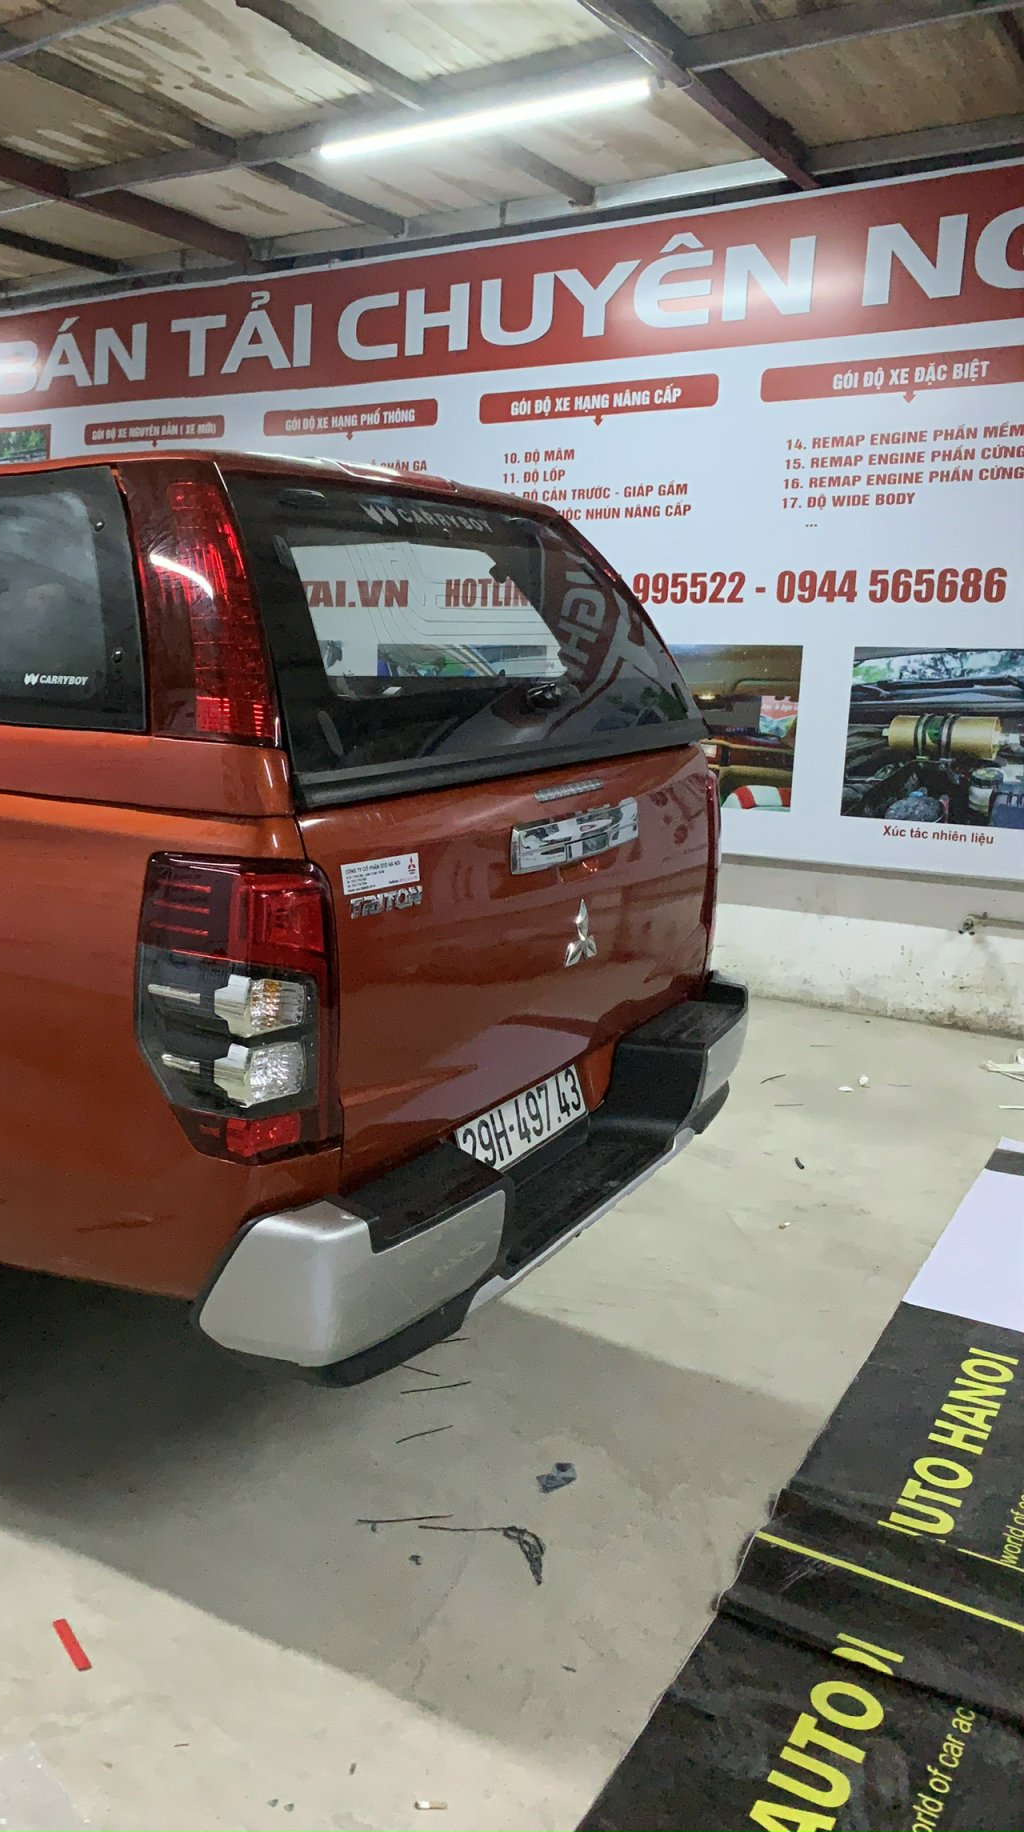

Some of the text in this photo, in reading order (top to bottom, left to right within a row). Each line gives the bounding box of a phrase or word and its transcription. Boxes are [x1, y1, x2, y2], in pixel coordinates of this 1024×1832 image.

[171, 290, 314, 377] TẢI
[336, 232, 817, 361] CHUYÊN
[833, 358, 989, 391] GÓI ĐỘ XE ĐẶC BIỆT
[510, 383, 682, 417] GÓI ĐỘ XE HẠNG NÂNG CẤP
[317, 417, 328, 429] XE
[786, 438, 807, 451] 14.
[811, 434, 865, 449] REMAP
[870, 430, 927, 446] ENGINE
[412, 459, 427, 471] GA
[503, 447, 575, 465] 10. ĐỘ MÂM
[784, 458, 805, 470] 15.
[810, 454, 863, 469] REMAP
[868, 451, 925, 466] ENGINE
[502, 472, 519, 484] 11.
[523, 469, 540, 486] ĐỘ
[783, 478, 804, 490] 16.
[808, 474, 862, 489] REMAP
[866, 471, 924, 486] ENGINE
[570, 485, 610, 500] TRƯỚC
[624, 483, 653, 498] GIÁP
[781, 492, 916, 510] 17. ĐỘ WIDE BODY
[624, 502, 660, 518] NÂNG
[632, 571, 746, 605] 995522
[776, 569, 858, 604] 0944
[869, 566, 1008, 605] 565686
[39, 674, 88, 685] CARRYBOY
[883, 825, 994, 846] Xúc tác nhiên liệu
[350, 885, 423, 919] TRITON
[462, 1068, 581, 1168] 29H-497.43
[927, 1347, 1019, 1455] HANOI
[938, 1733, 966, 1768] car
[926, 1765, 953, 1793] of
